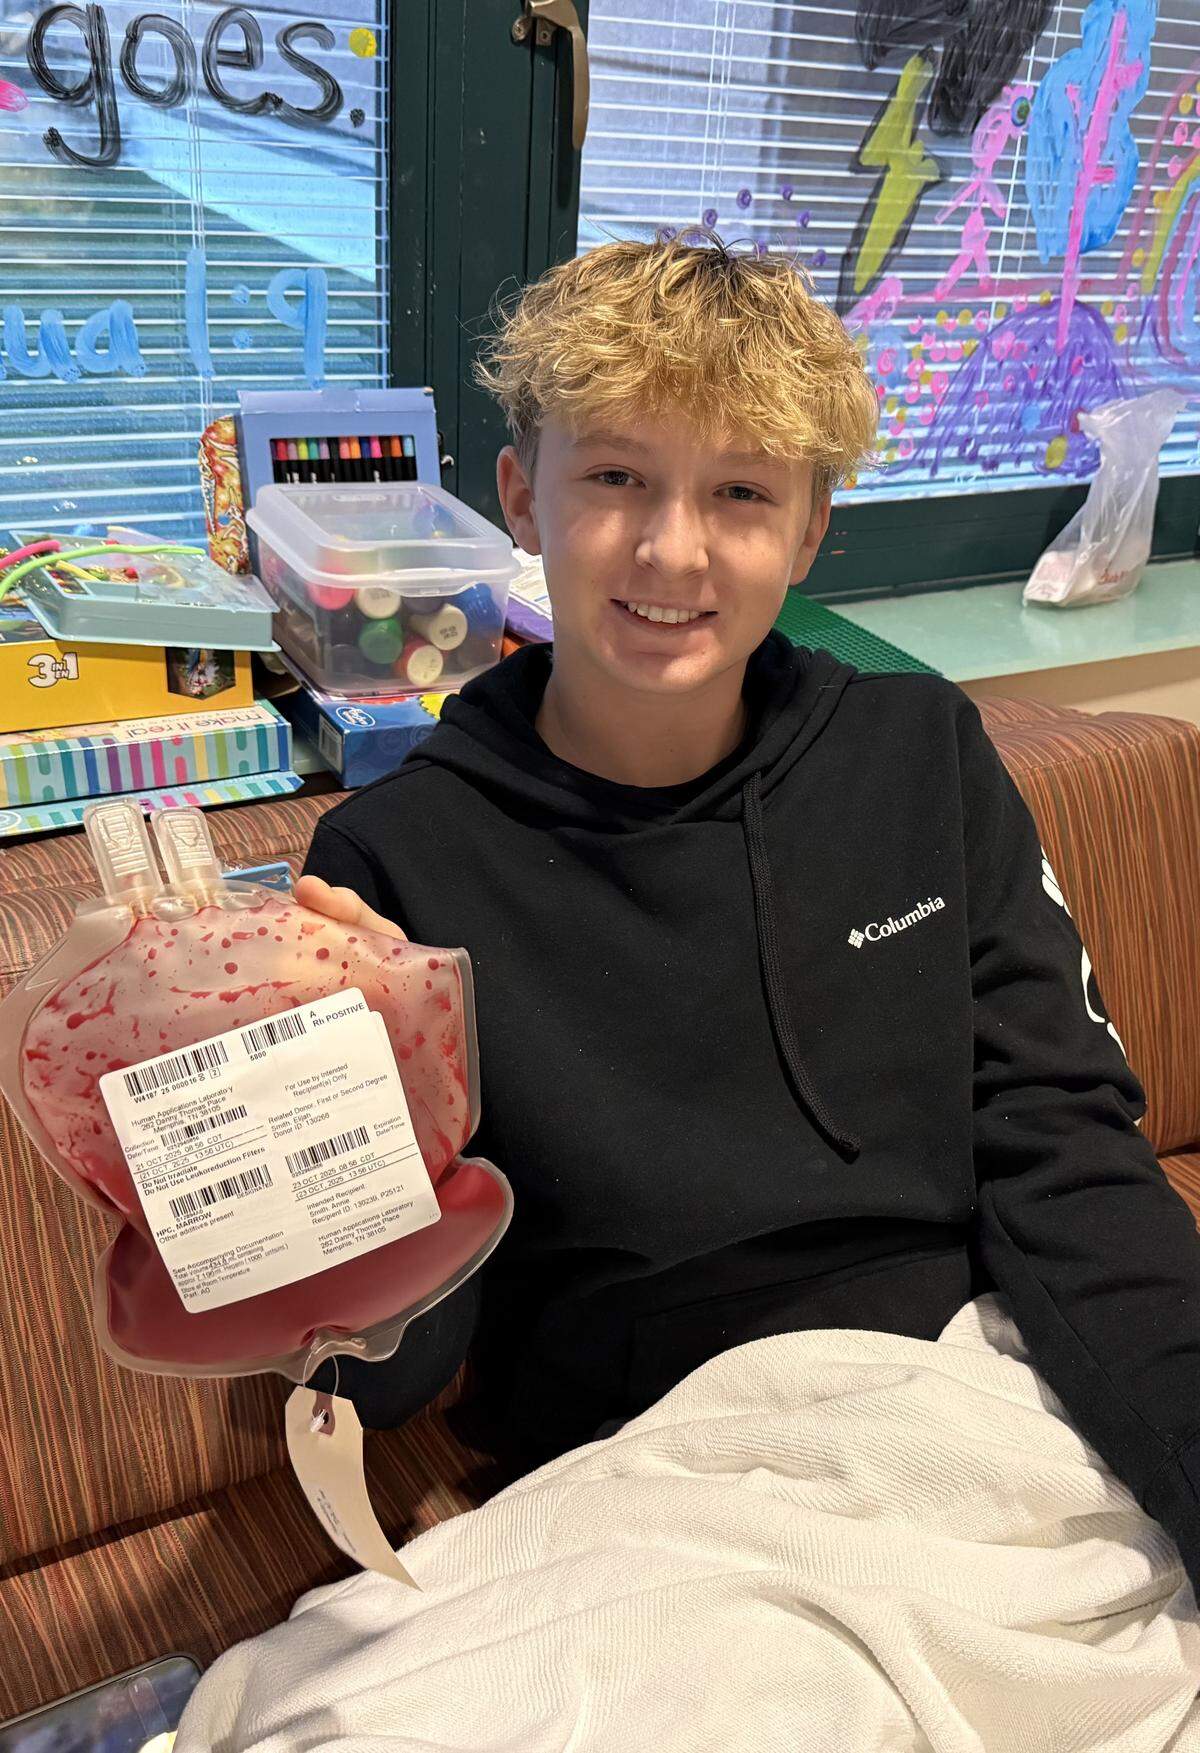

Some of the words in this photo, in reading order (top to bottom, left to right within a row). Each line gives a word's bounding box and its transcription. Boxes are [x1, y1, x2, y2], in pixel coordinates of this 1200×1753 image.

[26, 2, 367, 167] goes.
[0, 300, 146, 384] ua
[27, 653, 58, 688] 3
[51, 662, 64, 672] IN
[62, 652, 79, 680] 1
[126, 723, 171, 738] real
[177, 722, 190, 731] it
[195, 712, 263, 727] make
[865, 896, 946, 941] Columbia
[308, 1009, 317, 1019] A
[312, 1017, 325, 1027] Rh
[324, 1001, 365, 1022] POSITIVE
[284, 1082, 297, 1092] For
[296, 1077, 311, 1087] Use
[310, 1073, 320, 1083] by
[319, 1062, 349, 1079] Intended
[291, 1077, 332, 1098] Recipient(s)
[331, 1071, 348, 1083] Only
[160, 1086, 170, 1095] 25
[267, 1108, 294, 1124] Related
[316, 1094, 332, 1105] First
[339, 1082, 364, 1096] Second
[364, 1073, 388, 1087] Degree
[130, 1112, 156, 1127] Human
[155, 1098, 197, 1119] Applications
[140, 1120, 154, 1131] 262
[154, 1112, 178, 1126] Danny
[178, 1102, 207, 1117] Thomas
[206, 1094, 226, 1106] Place
[187, 1112, 198, 1121] TN
[198, 1104, 221, 1117] 38105
[292, 1111, 312, 1124] Elijah
[372, 1115, 402, 1130] Expiration
[273, 1125, 294, 1139] Donor
[374, 1120, 405, 1137] Date/Time
[123, 1137, 155, 1153] Collection
[134, 1161, 146, 1171] 21
[145, 1155, 164, 1167] OCT
[163, 1148, 182, 1160] 2025
[205, 1133, 223, 1145] CDT
[143, 1187, 155, 1196] Do
[155, 1181, 169, 1192] Not
[169, 1176, 185, 1187] Use
[184, 1155, 242, 1181] Leukoreduction
[241, 1145, 266, 1159] Filters
[171, 1156, 190, 1168] 2025
[291, 1179, 303, 1189] 23
[301, 1173, 318, 1185] OCT
[319, 1166, 337, 1178] 2025
[359, 1151, 376, 1163] CDT
[141, 1180, 153, 1190] Do
[152, 1175, 167, 1186] Not
[166, 1164, 198, 1181] Irradiate
[295, 1188, 309, 1200] (23
[326, 1174, 344, 1186] 2025
[366, 1158, 386, 1171] UTC)
[306, 1194, 335, 1210] Intended
[330, 1196, 350, 1209] Annie
[155, 1225, 176, 1238] HPC,
[174, 1210, 213, 1230] MARROW
[158, 1231, 179, 1244] Other
[178, 1220, 208, 1237] additives
[208, 1210, 235, 1226] present
[311, 1208, 342, 1225] Recipient
[317, 1228, 342, 1242] Human
[341, 1213, 381, 1233] Applications
[380, 1199, 414, 1218] Laboratory
[333, 1230, 355, 1244] Danny
[355, 1220, 382, 1235] Thomas
[381, 1213, 400, 1224] Place
[354, 1233, 365, 1243] TN
[365, 1225, 387, 1238] 38105
[171, 1265, 186, 1275] See
[186, 1248, 235, 1272] Accompanying
[234, 1229, 284, 1253] Documentation
